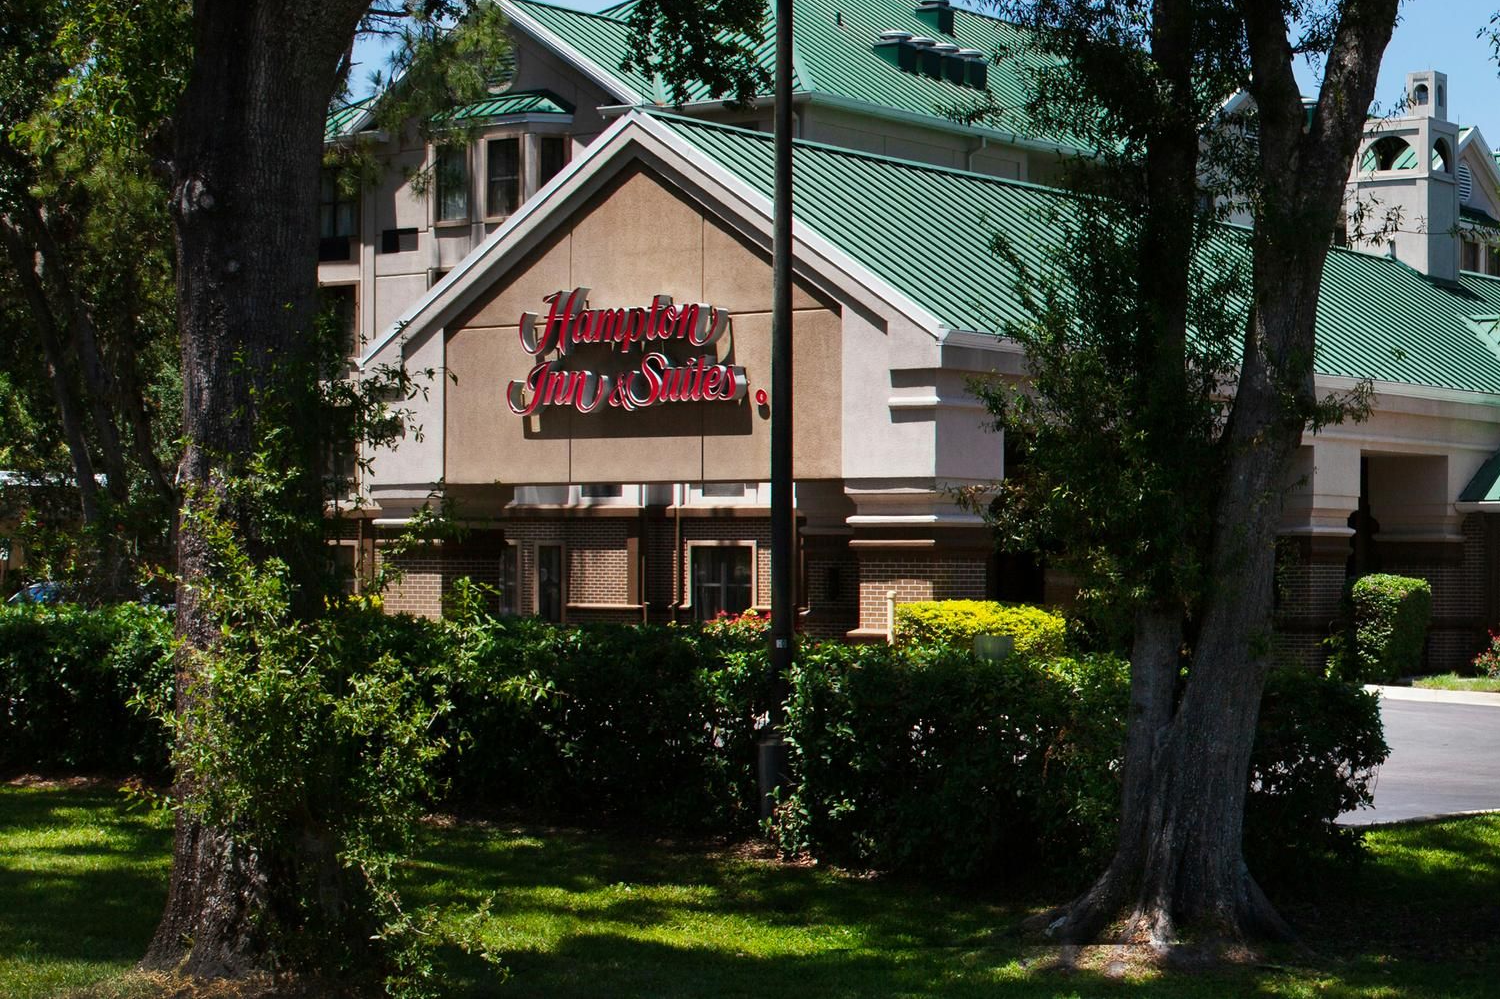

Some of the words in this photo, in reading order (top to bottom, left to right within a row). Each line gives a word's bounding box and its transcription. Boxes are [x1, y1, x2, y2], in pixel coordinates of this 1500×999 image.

[520, 287, 728, 355] Hampton
[507, 361, 608, 416] Inn
[608, 374, 634, 412] &
[625, 352, 745, 407] Suites
